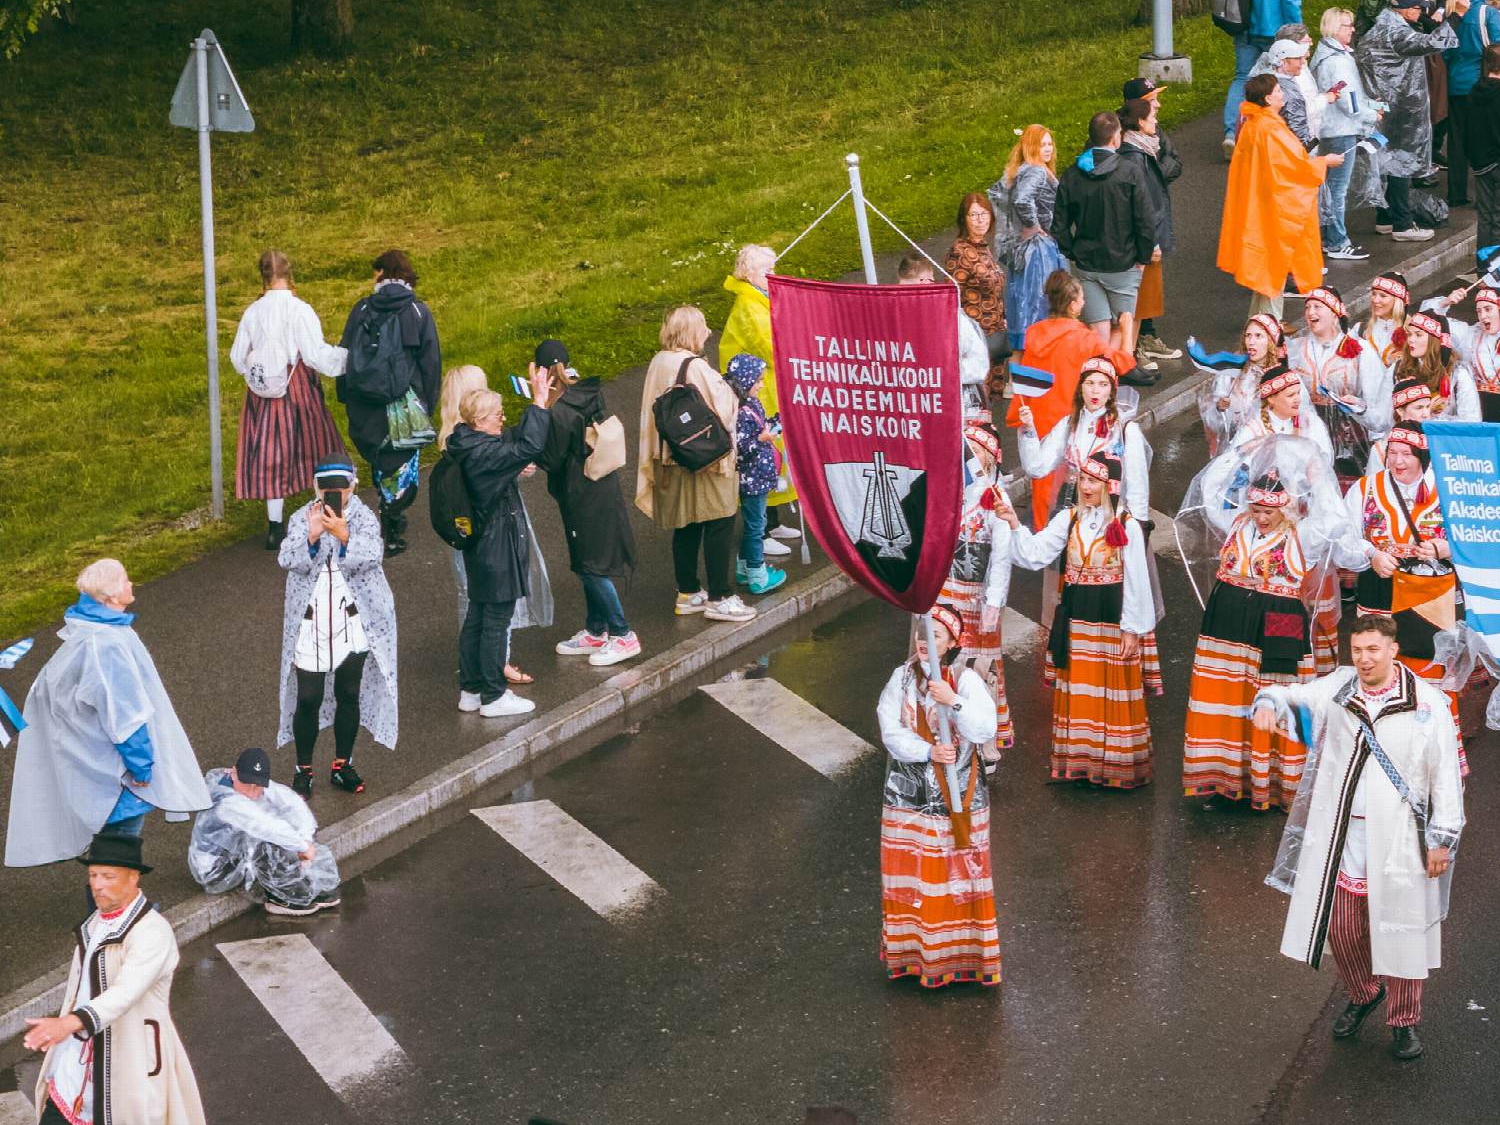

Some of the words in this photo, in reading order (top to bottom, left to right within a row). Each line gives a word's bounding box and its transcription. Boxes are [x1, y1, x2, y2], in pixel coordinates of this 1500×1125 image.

[814, 335, 916, 363] TALLINNA
[788, 357, 942, 388] TEHNIKAÜLIKOOLI
[792, 383, 943, 414] AKADEEMILINE
[820, 411, 922, 440] NAISKOOR
[1440, 453, 1494, 474] Tallinna
